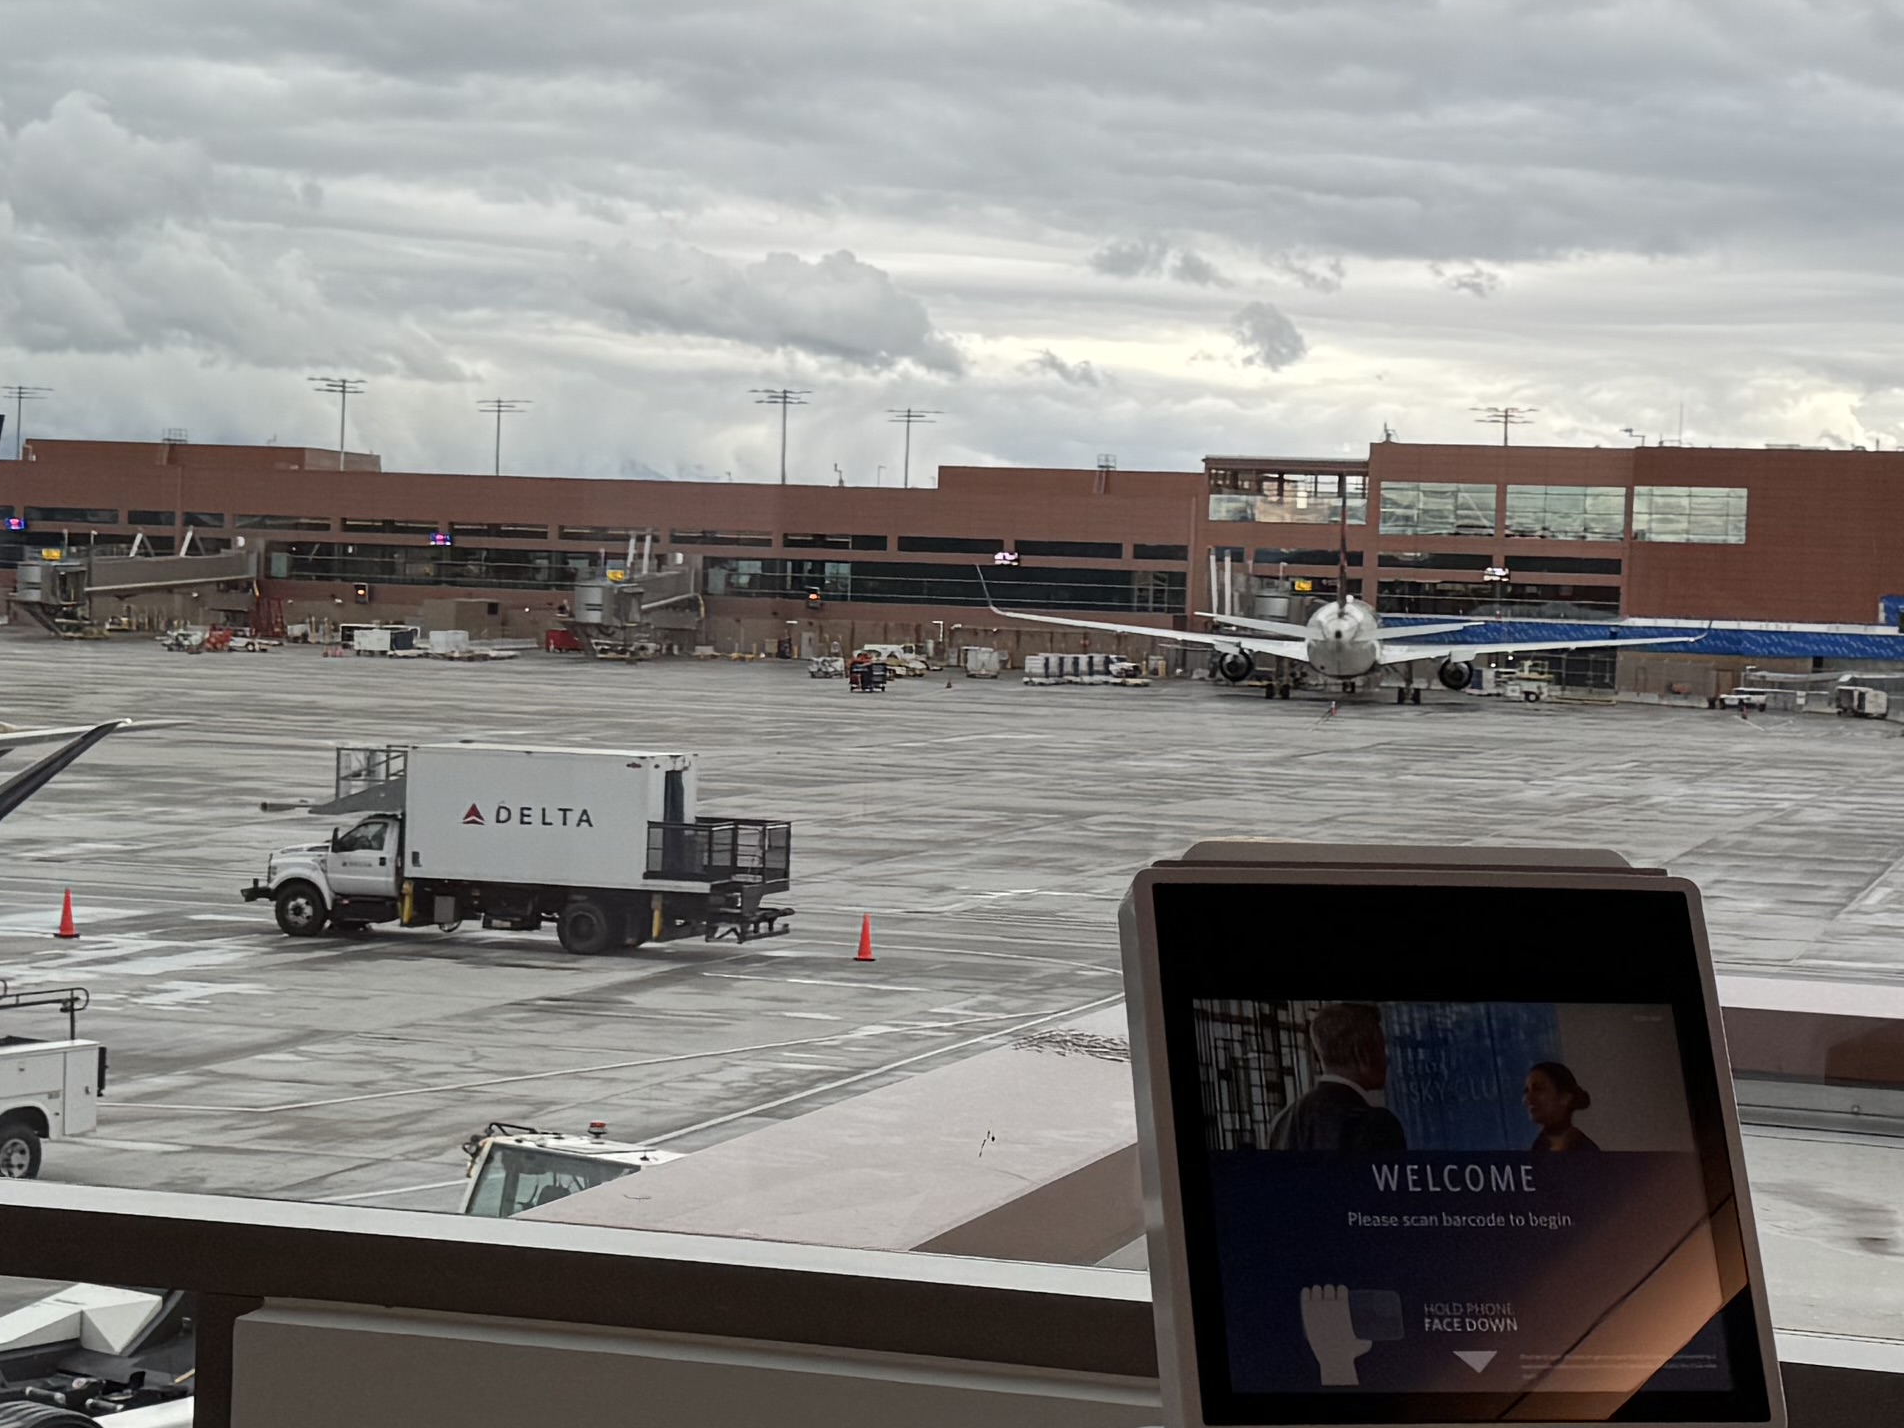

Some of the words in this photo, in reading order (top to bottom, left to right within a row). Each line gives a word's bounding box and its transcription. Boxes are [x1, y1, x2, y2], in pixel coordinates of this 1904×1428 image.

[495, 805, 594, 828] DELTA
[1371, 1163, 1537, 1192] WELCOME
[1348, 1212, 1399, 1227] Please
[1402, 1215, 1439, 1227] scan
[1442, 1212, 1506, 1227] barcode
[1509, 1213, 1525, 1227] to
[1528, 1212, 1572, 1230] begin
[1423, 1303, 1464, 1316] HOLD
[1424, 1318, 1462, 1332] FACE
[1465, 1318, 1518, 1332] DOWN
